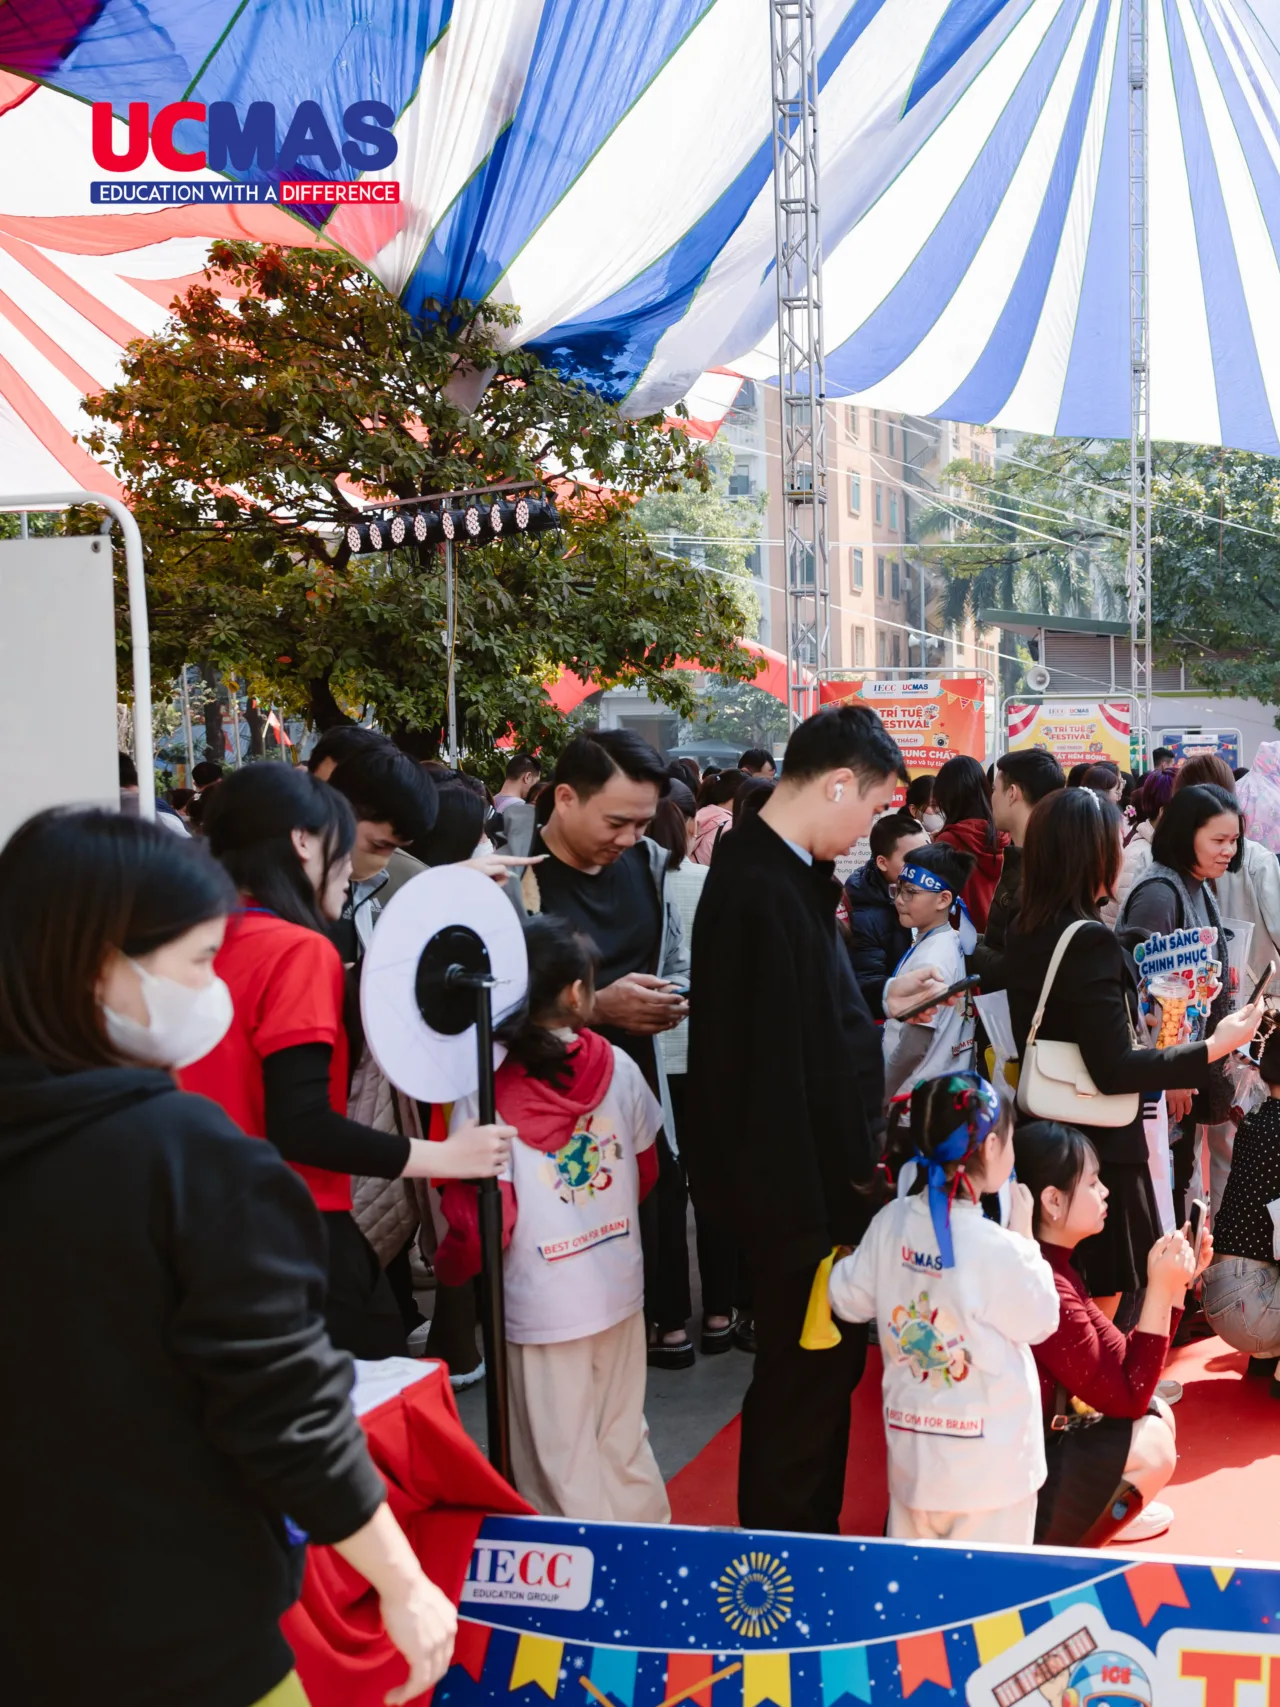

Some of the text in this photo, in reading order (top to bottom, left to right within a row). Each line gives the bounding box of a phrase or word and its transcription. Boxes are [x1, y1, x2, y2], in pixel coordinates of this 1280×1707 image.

[873, 683, 929, 692] IECC UCMAS
[879, 706, 923, 720] TRÍ TUỆ
[883, 719, 930, 729] ESTIVAL
[900, 750, 927, 758] BUNG
[900, 867, 916, 879] AS
[1145, 930, 1200, 956] SẴN SÀNG
[1141, 948, 1208, 976] CHINH PHỤC
[544, 1241, 569, 1255] BEST
[600, 1220, 625, 1236] BRAIN
[902, 1245, 943, 1271] UCMAS
[924, 1416, 943, 1428] FOR
[946, 1418, 978, 1430] BRAIN
[465, 1547, 573, 1589] IECC
[473, 1588, 560, 1602] EDUCATION GROUP
